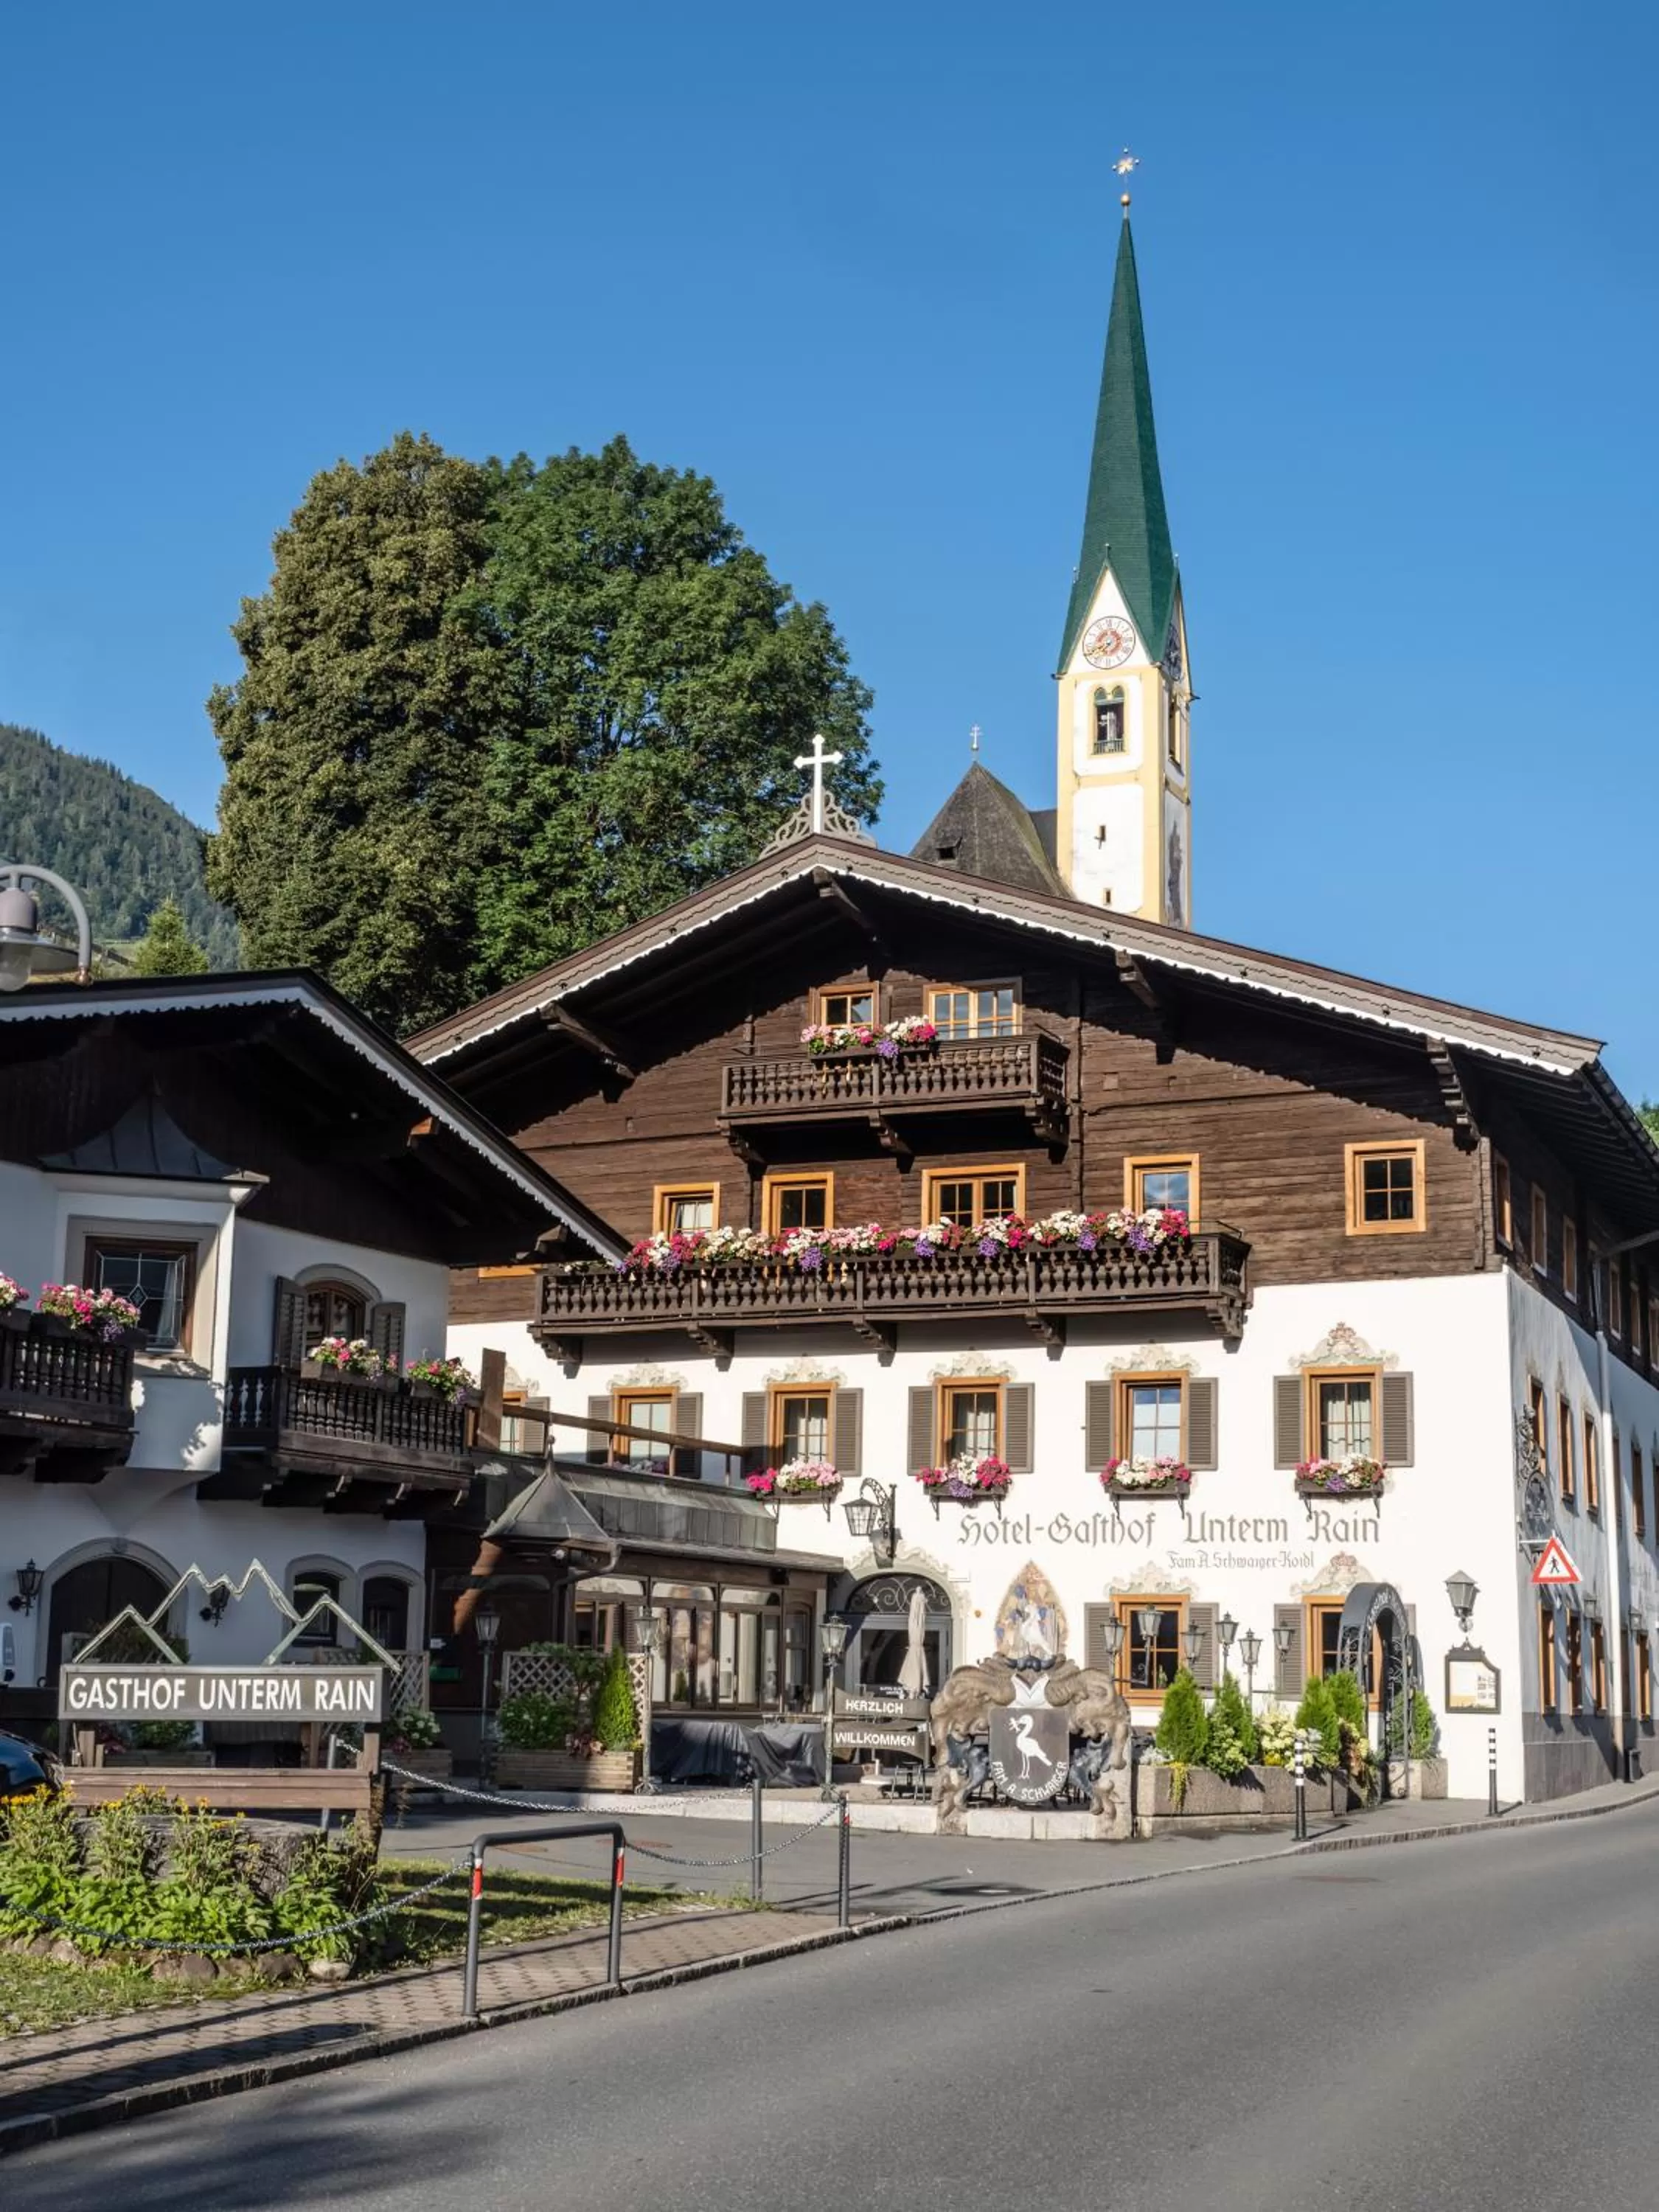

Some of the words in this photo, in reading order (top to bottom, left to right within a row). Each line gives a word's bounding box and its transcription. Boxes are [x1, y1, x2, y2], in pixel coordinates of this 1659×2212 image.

[1183, 1511, 1288, 1543] Unterm
[1307, 1510, 1380, 1543] Rain
[69, 1677, 187, 1710] GASTHOF
[198, 1678, 302, 1710] UNTERM
[315, 1679, 375, 1711] RAIN
[845, 1699, 903, 1714] HERZLICH
[834, 1732, 915, 1747] WILLKOMMEN
